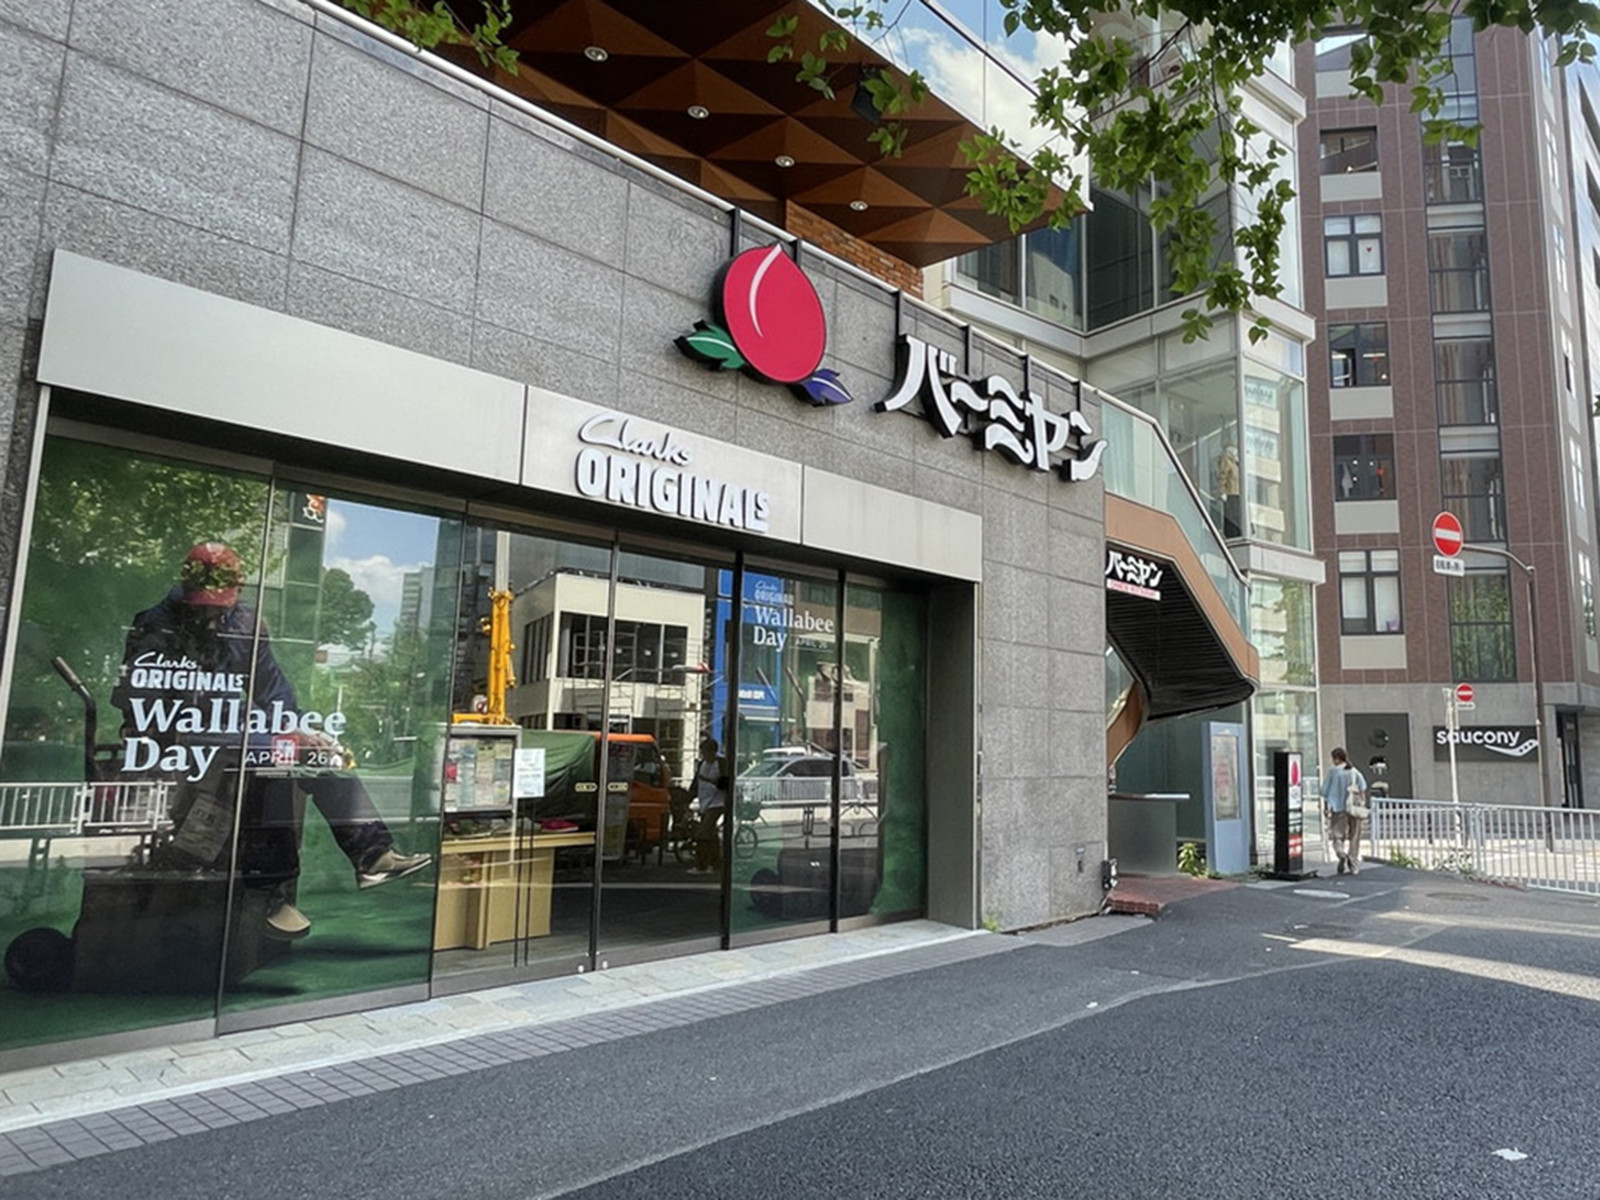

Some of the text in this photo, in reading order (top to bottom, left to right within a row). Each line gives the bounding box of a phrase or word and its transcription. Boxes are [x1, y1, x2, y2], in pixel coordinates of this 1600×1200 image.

[879, 334, 1107, 482] バーミヤン
[578, 410, 692, 466] Clarks
[575, 447, 770, 534] ORIGINALS
[754, 605, 835, 634] Wallabee
[753, 625, 788, 653] Day
[133, 651, 198, 670] Clarks
[130, 667, 245, 693] ORIGINALS
[129, 697, 347, 737] Wallabee
[1436, 730, 1521, 747] saucony
[120, 736, 221, 783] Day
[306, 751, 329, 765] 26
